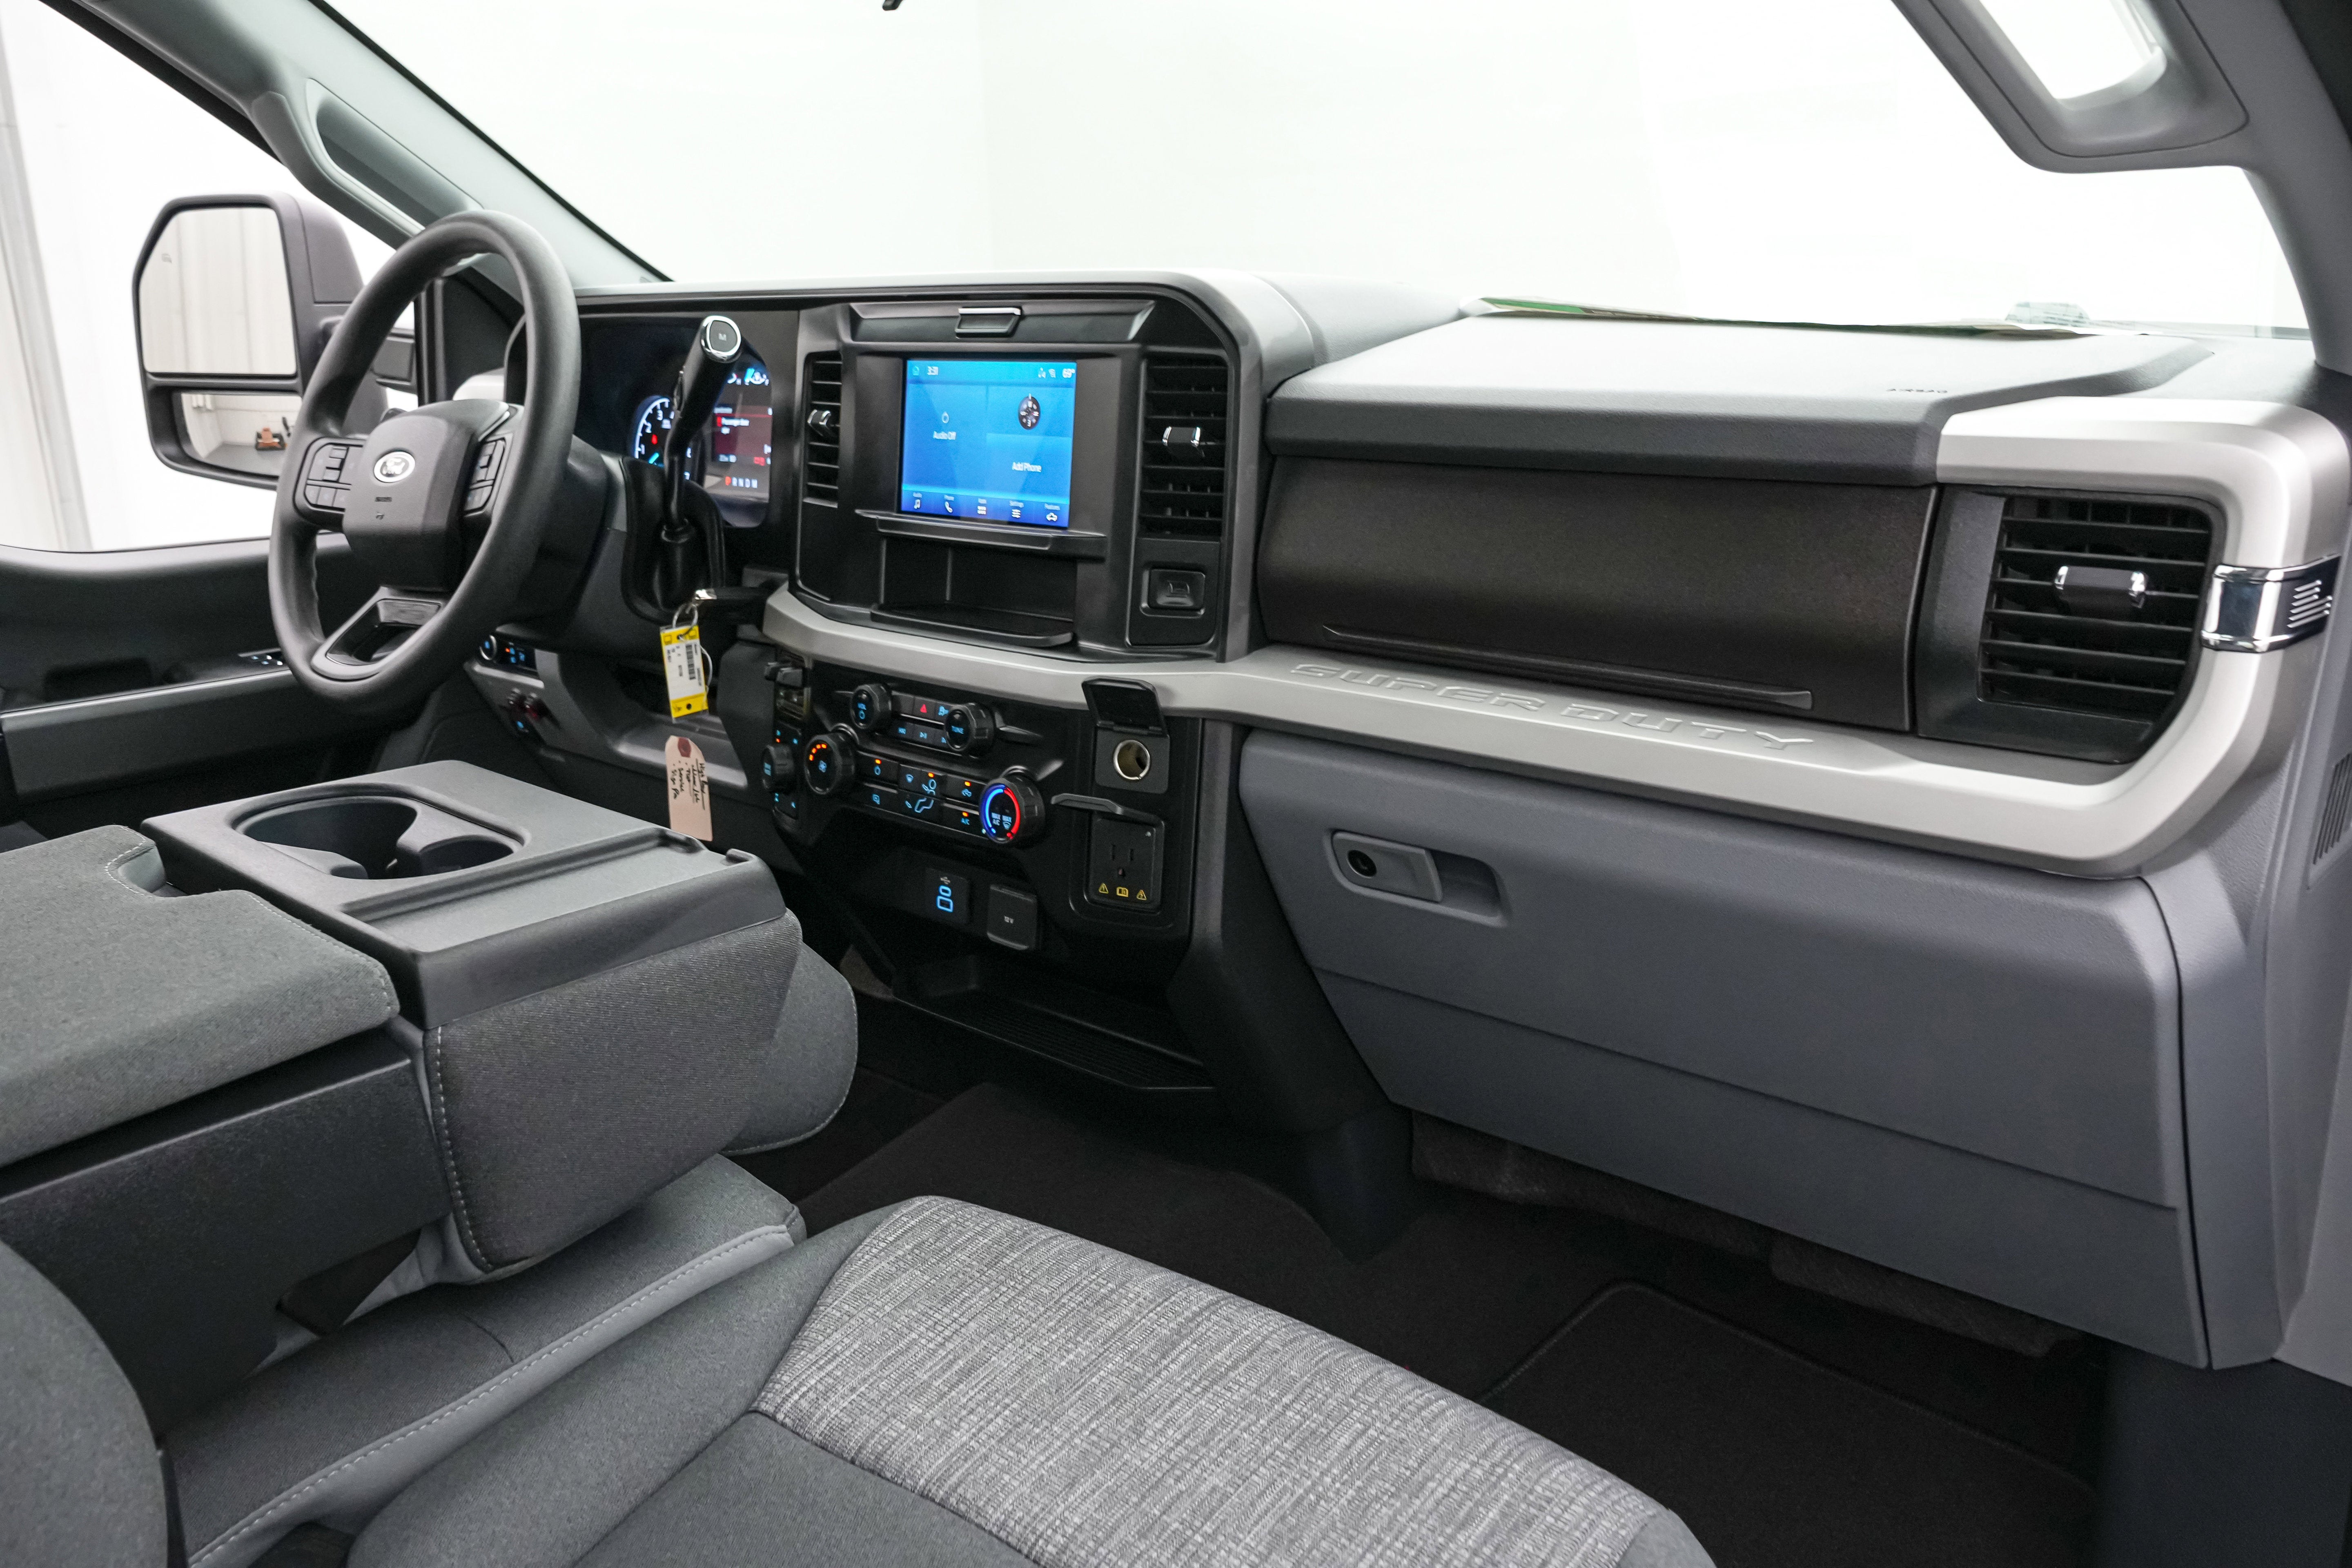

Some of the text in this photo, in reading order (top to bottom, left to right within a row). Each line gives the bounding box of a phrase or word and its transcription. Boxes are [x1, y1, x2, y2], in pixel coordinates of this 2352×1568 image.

[951, 725, 964, 735] TUNE
[1290, 664, 1814, 751] SUPER DUTY
